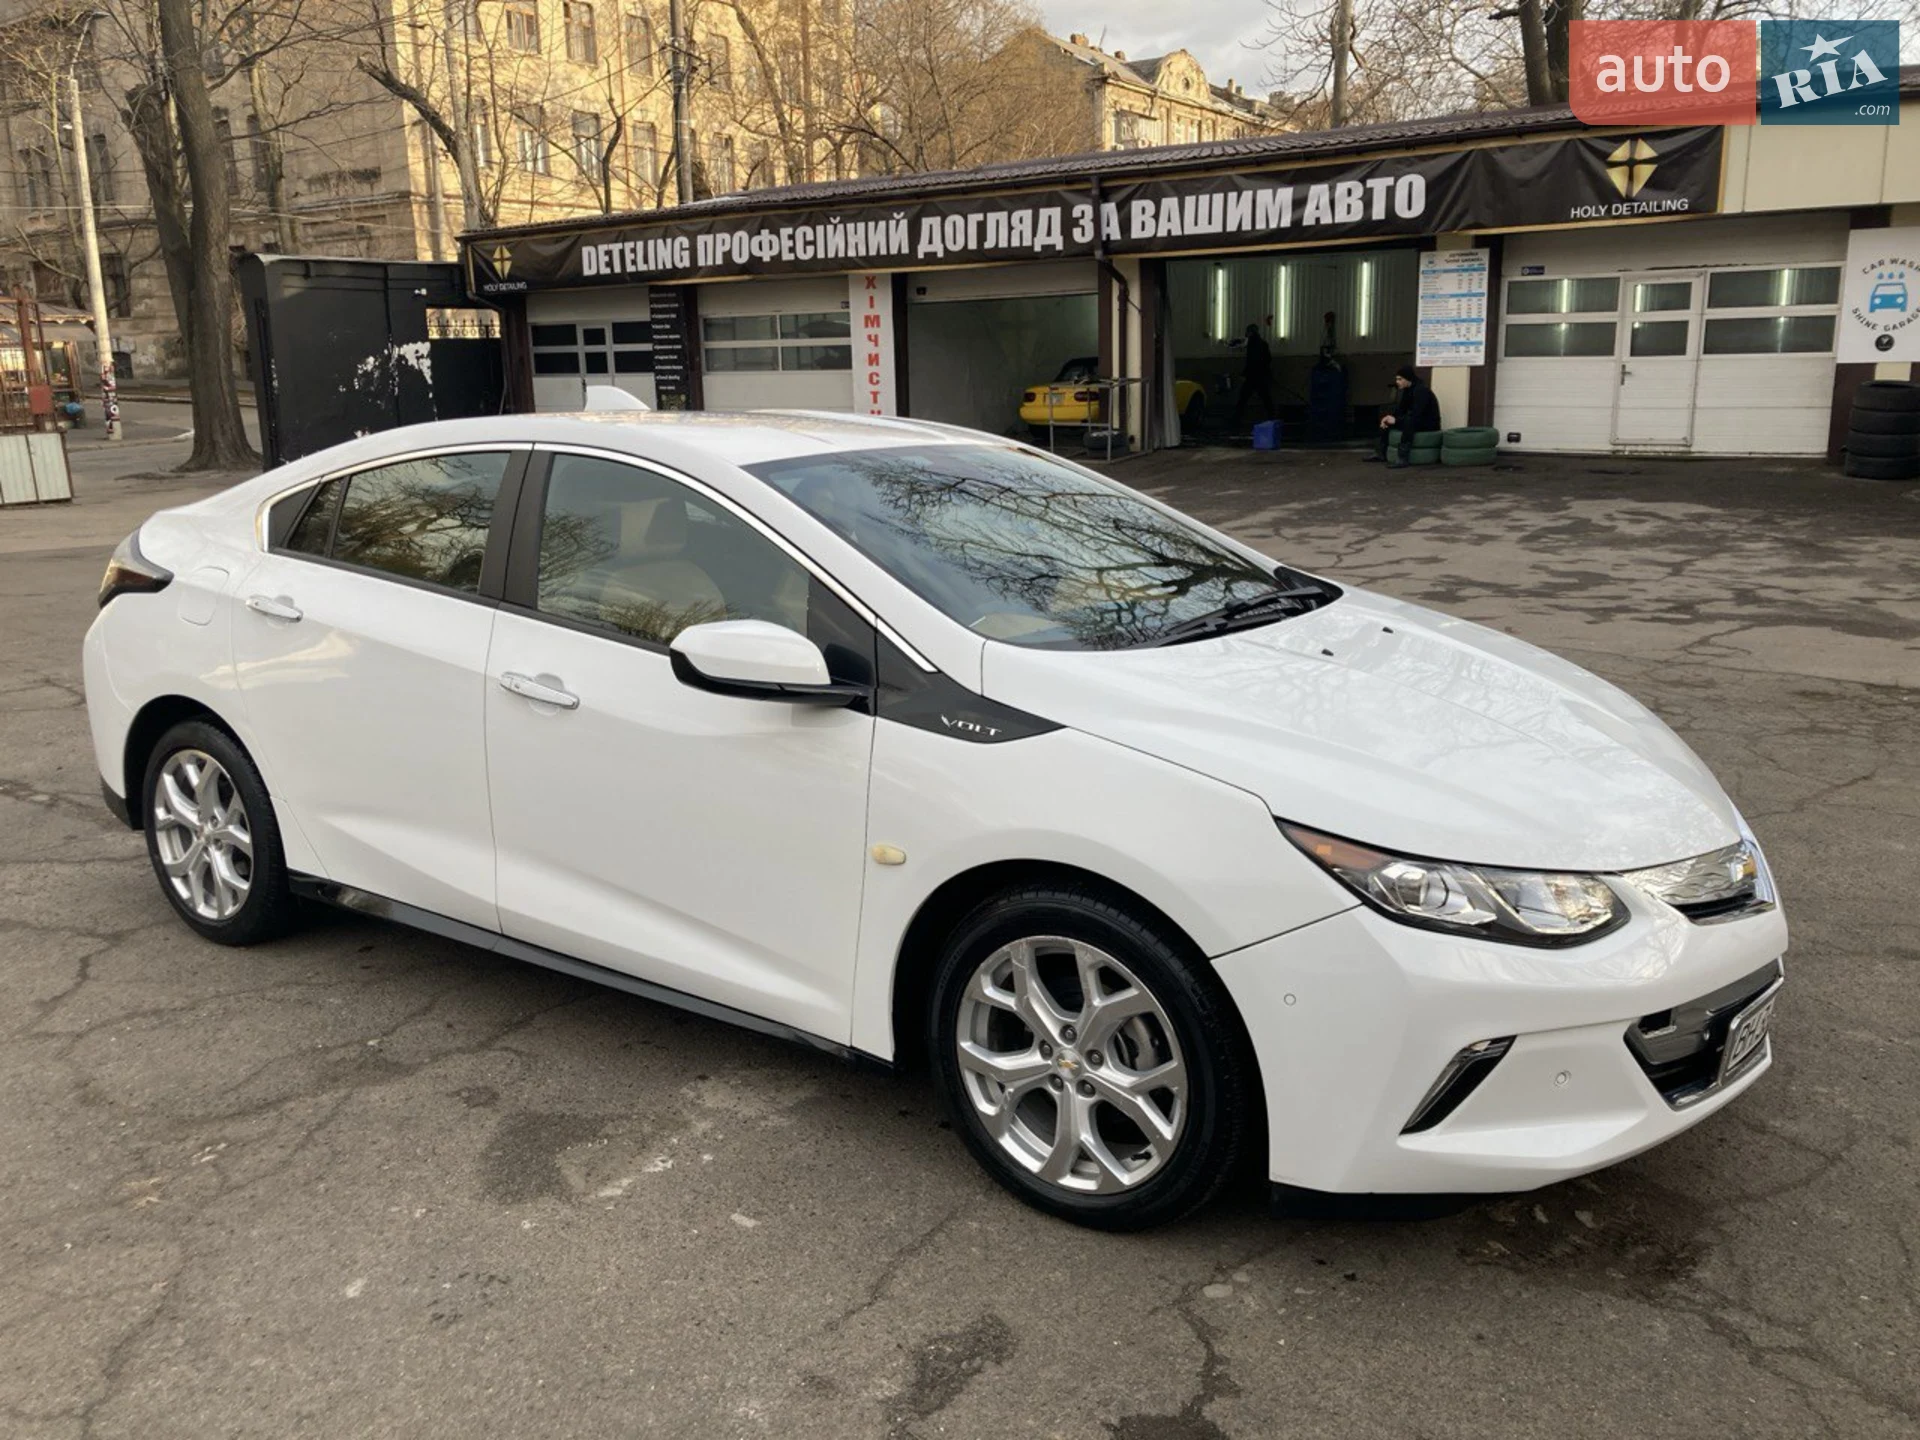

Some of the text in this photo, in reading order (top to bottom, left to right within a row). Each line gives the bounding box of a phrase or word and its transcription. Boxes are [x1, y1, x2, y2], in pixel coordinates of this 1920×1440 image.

[1570, 198, 1689, 219] HOLY DETAILING
[582, 173, 1426, 277] DETELING ПРОФЕСІЙНИЙ ДОГЛЯД ЗА ВАШИМ АВТО
[1862, 259, 1885, 275] CAR
[1852, 307, 1879, 331] SHINE
[863, 275, 882, 416] ХІМЧИСТ
[941, 713, 1003, 737] VOLT
